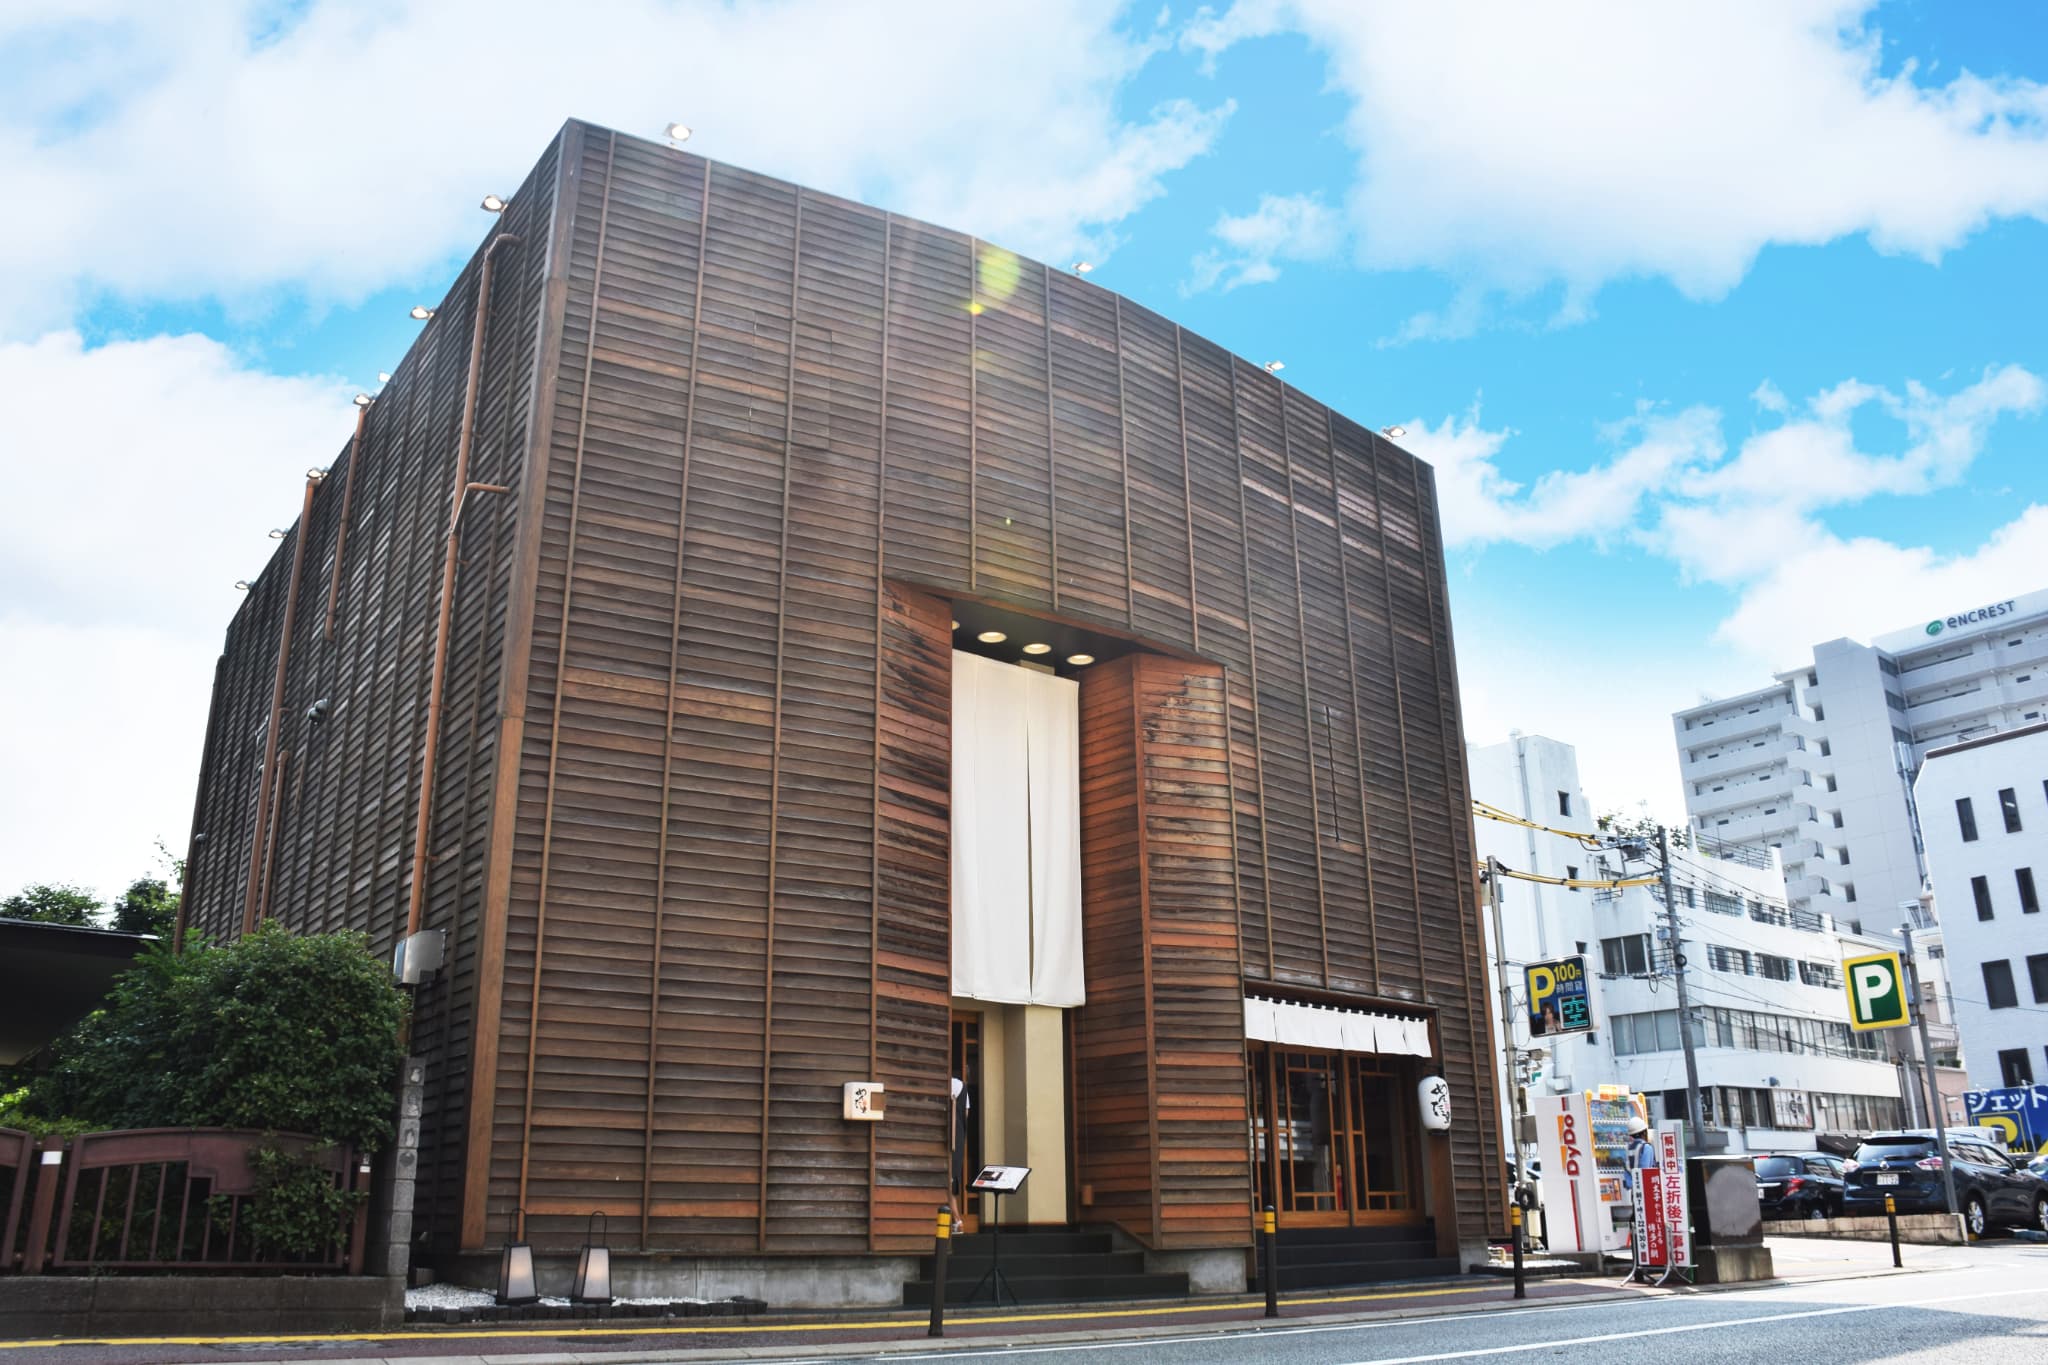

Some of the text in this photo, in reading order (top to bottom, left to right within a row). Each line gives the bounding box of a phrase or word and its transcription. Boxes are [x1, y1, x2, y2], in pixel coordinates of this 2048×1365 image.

[1528, 972, 1556, 1015] P
[1854, 964, 1893, 1020] P
[1968, 1088, 2048, 1113] ジェット
[1563, 1114, 1582, 1176] DyDo
